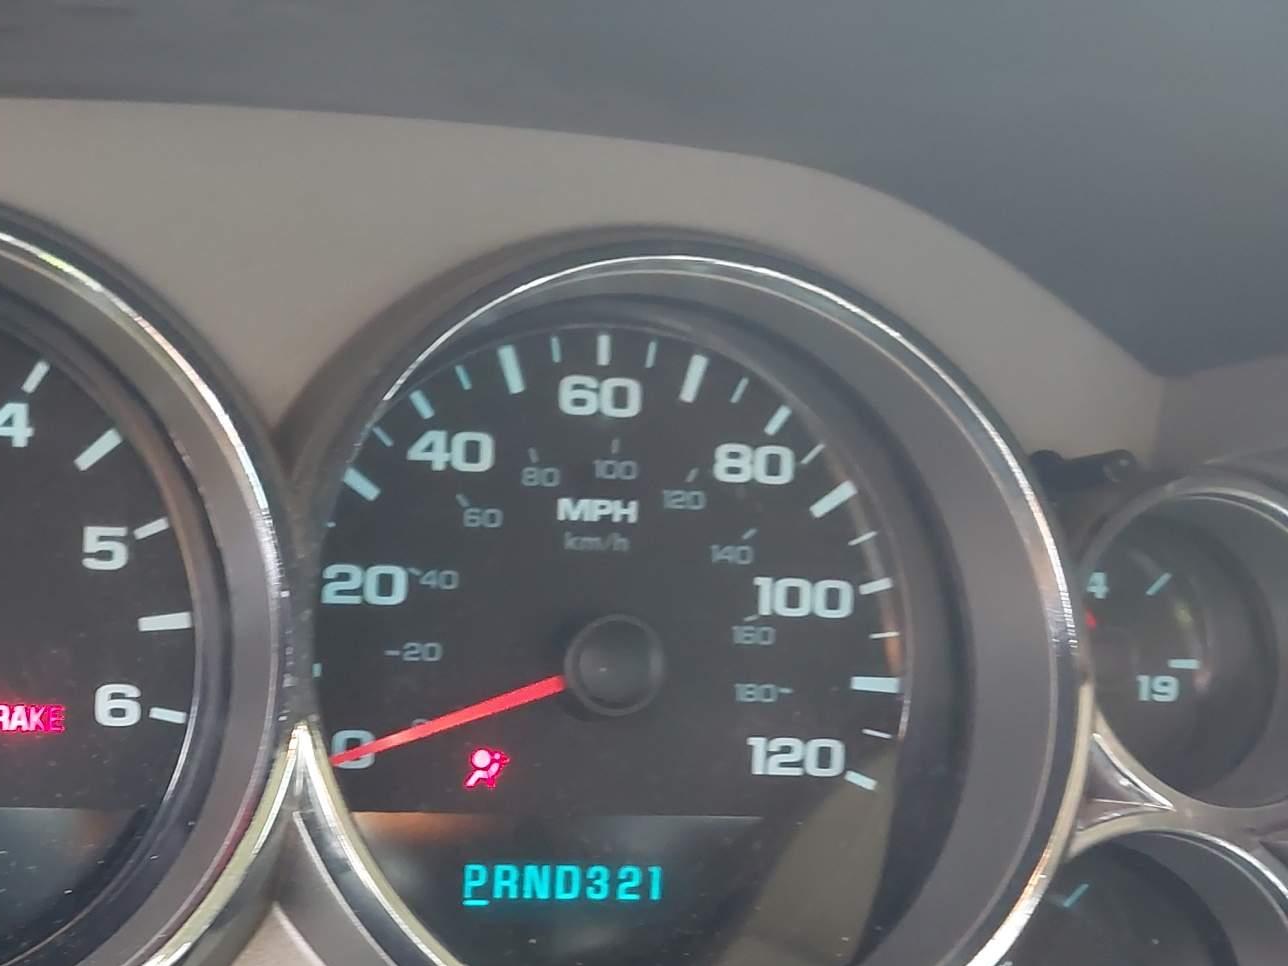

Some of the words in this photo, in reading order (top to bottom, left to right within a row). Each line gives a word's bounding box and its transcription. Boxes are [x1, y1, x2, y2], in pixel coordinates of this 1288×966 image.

[558, 375, 642, 418] 60
[407, 431, 494, 472] 40
[714, 444, 795, 485] 80
[522, 466, 560, 487] 80
[594, 460, 637, 481] 100
[463, 508, 503, 529] 60
[557, 498, 638, 524] MPH
[662, 490, 706, 511] 120
[82, 526, 128, 571] 5
[564, 532, 630, 552] km/h
[711, 545, 754, 565] 140
[322, 564, 407, 606] 20
[418, 570, 460, 591] 40
[753, 577, 854, 618] 100
[94, 684, 141, 726] 6
[1136, 675, 1179, 702] 19
[332, 729, 376, 769] 0
[746, 737, 845, 777] 120
[463, 864, 663, 901] PRND321
